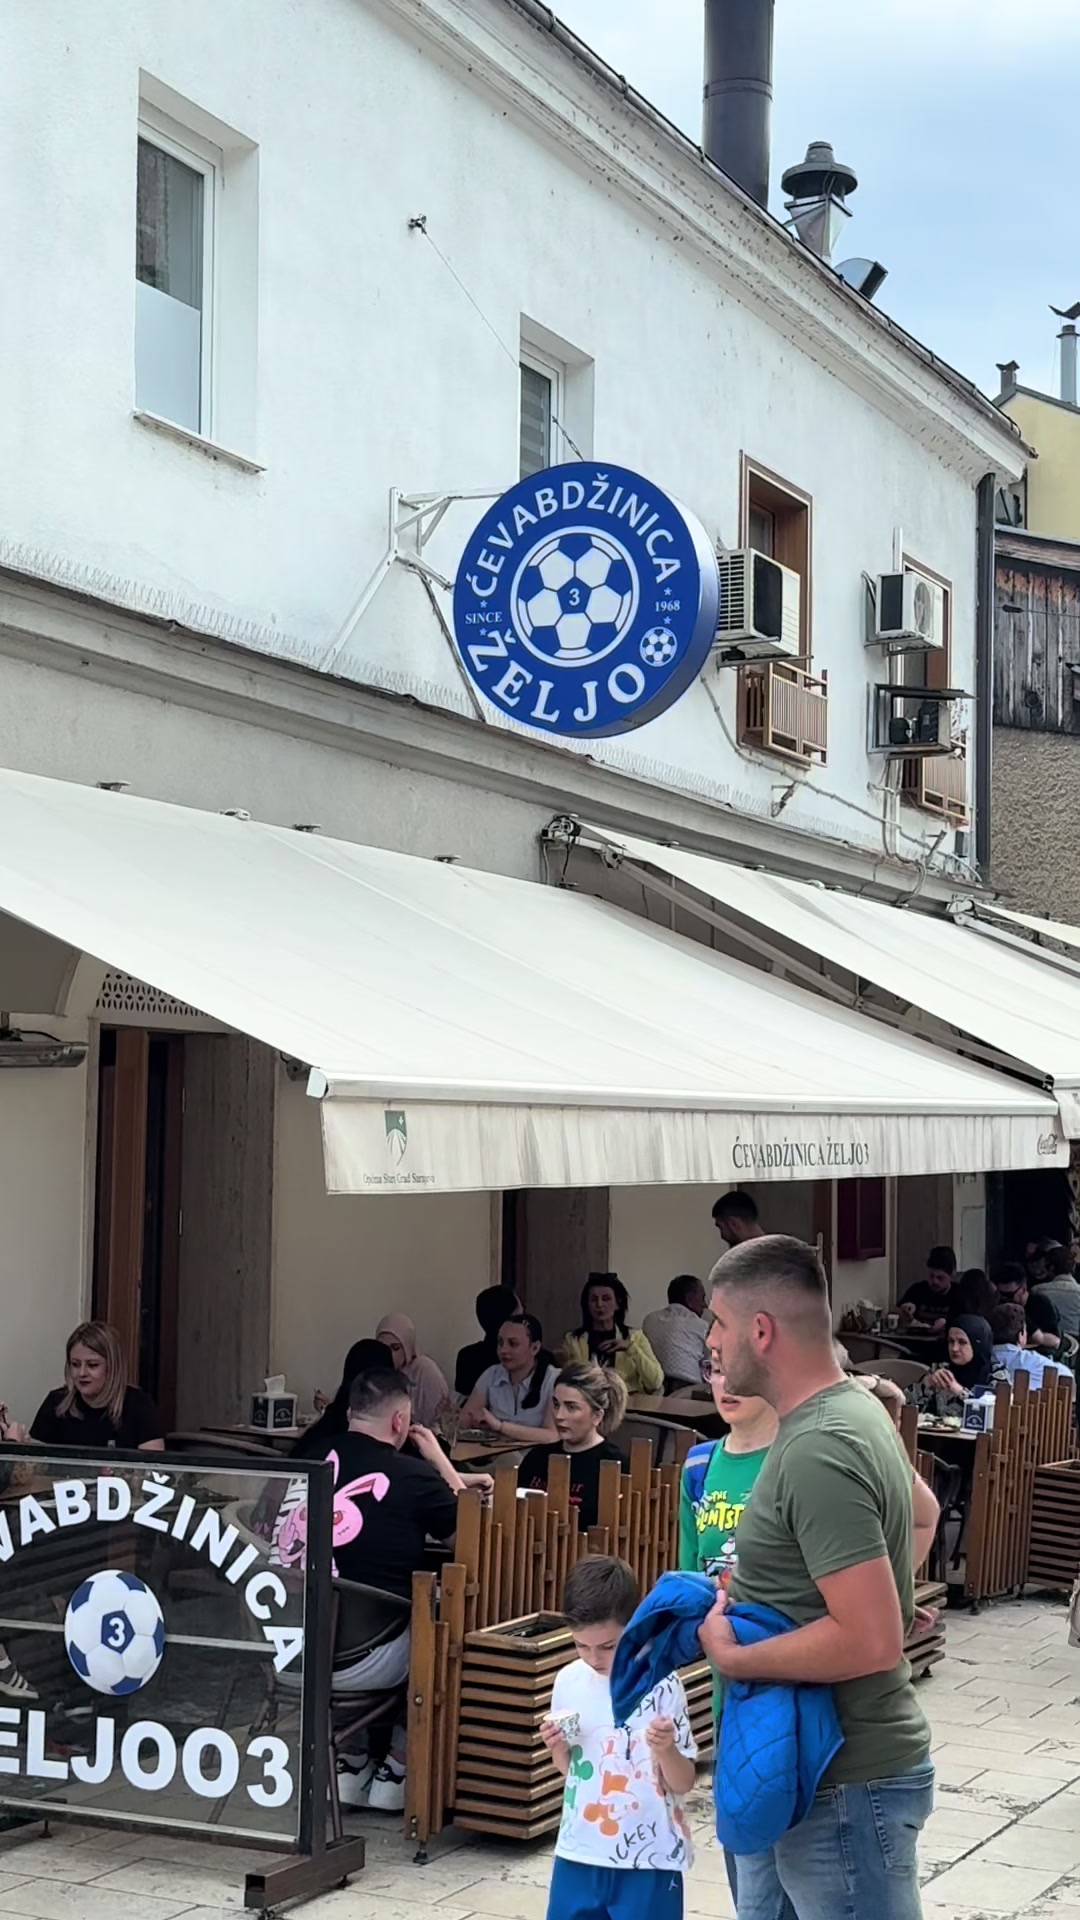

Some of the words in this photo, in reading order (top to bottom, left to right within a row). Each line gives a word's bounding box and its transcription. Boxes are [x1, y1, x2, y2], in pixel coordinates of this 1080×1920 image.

[465, 472, 681, 597] ĆEVABDŽINICA
[568, 587, 581, 607] 3
[465, 611, 503, 624] SINCE
[655, 600, 681, 612] 1968
[467, 628, 645, 723] ŽELJO
[711, 1490, 728, 1503] THE
[107, 1617, 125, 1648] 3
